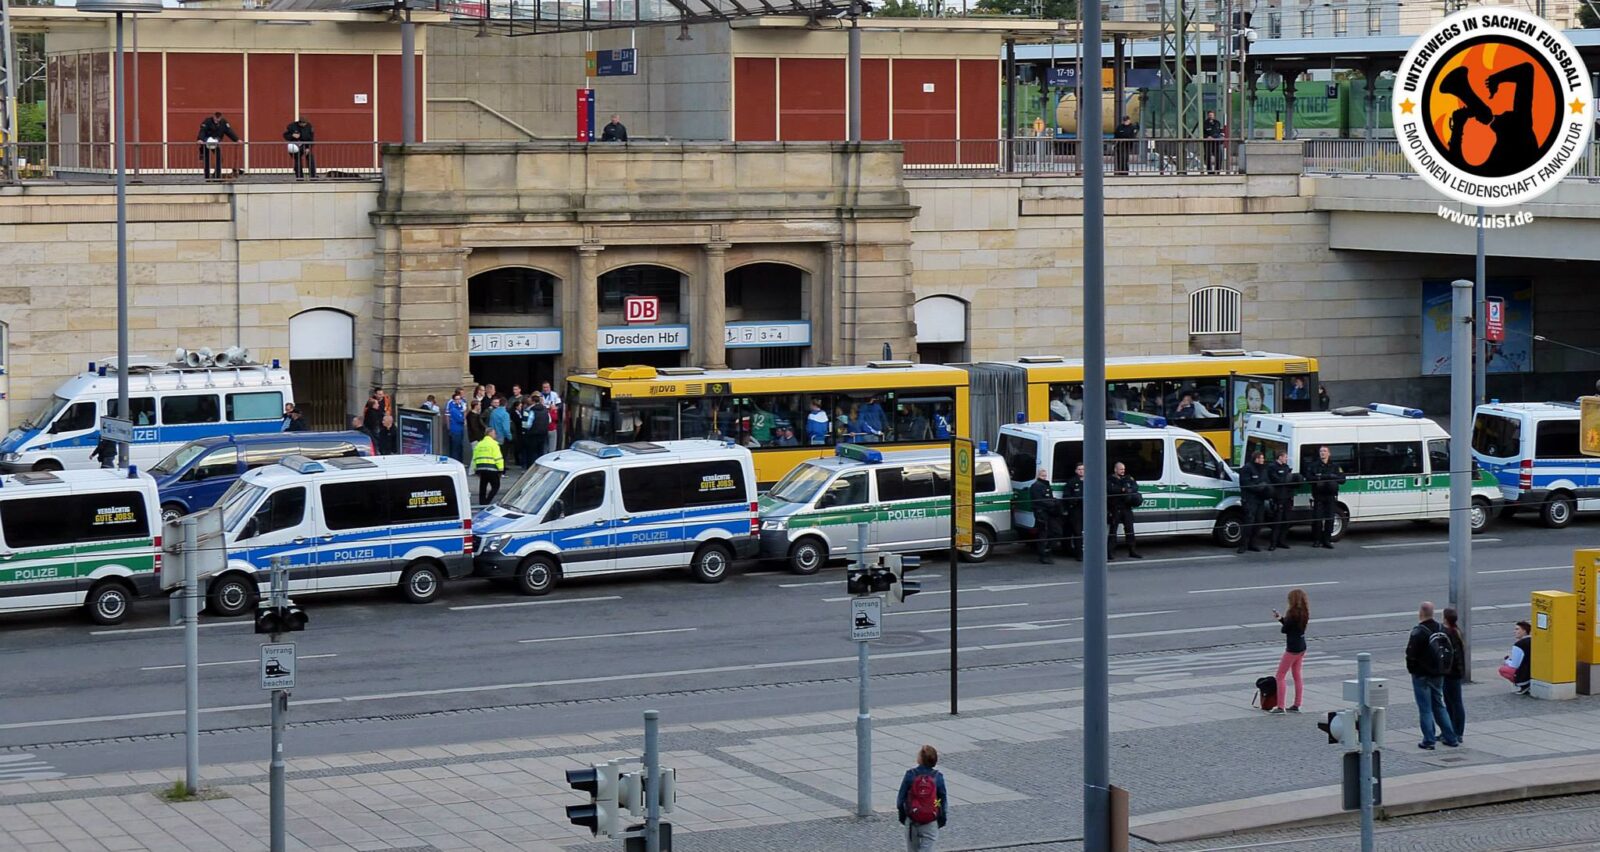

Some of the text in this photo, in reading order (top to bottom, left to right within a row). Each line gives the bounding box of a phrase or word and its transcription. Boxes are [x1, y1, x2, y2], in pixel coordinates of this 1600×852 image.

[1056, 68, 1074, 76] 17-19
[1256, 96, 1328, 113] HANGRTNER
[630, 300, 655, 318] DB
[605, 332, 679, 344] Dresden Hbf
[760, 332, 766, 340] 3
[490, 340, 498, 348] 17
[508, 340, 514, 348] 3
[524, 338, 530, 346] 4
[658, 384, 676, 392] DVB
[752, 412, 765, 427] 12
[132, 430, 157, 440] IZEI
[700, 481, 716, 489] GUTE
[716, 480, 734, 488] JOBS!
[1367, 479, 1406, 490] POLIZEI
[409, 497, 426, 506] GUTE
[426, 496, 445, 504] JOBS!
[95, 514, 112, 522] GUTE
[114, 512, 134, 520] JOBS!
[888, 508, 926, 520] POLIZEI
[632, 531, 668, 542] POLIZEI
[334, 549, 374, 560] POLIZEI
[15, 568, 58, 580] POLIZEI
[1577, 566, 1586, 613] Tickets
